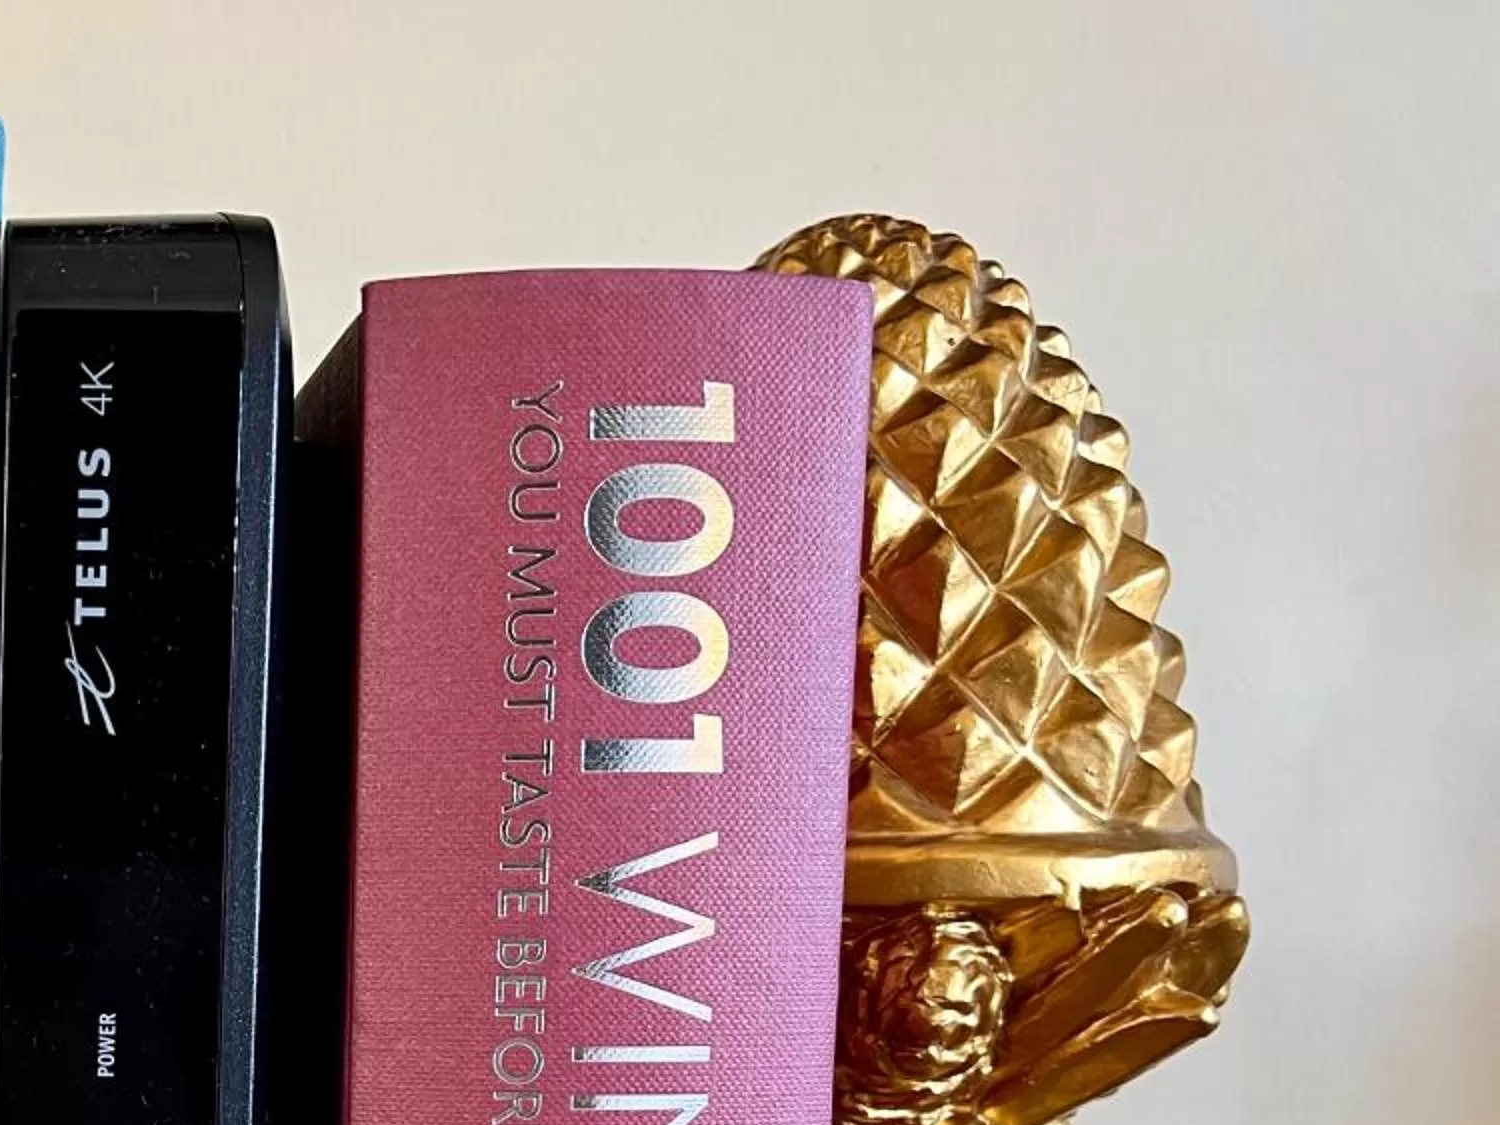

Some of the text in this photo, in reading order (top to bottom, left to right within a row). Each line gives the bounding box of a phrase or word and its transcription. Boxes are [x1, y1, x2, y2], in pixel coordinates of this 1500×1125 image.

[80, 361, 114, 416] 4K
[509, 380, 564, 522] YOU
[74, 447, 111, 626] TELUS
[581, 380, 735, 773] 1001
[504, 545, 557, 722] MUST
[497, 739, 553, 919] TASTE
[97, 1012, 117, 1078] POWER
